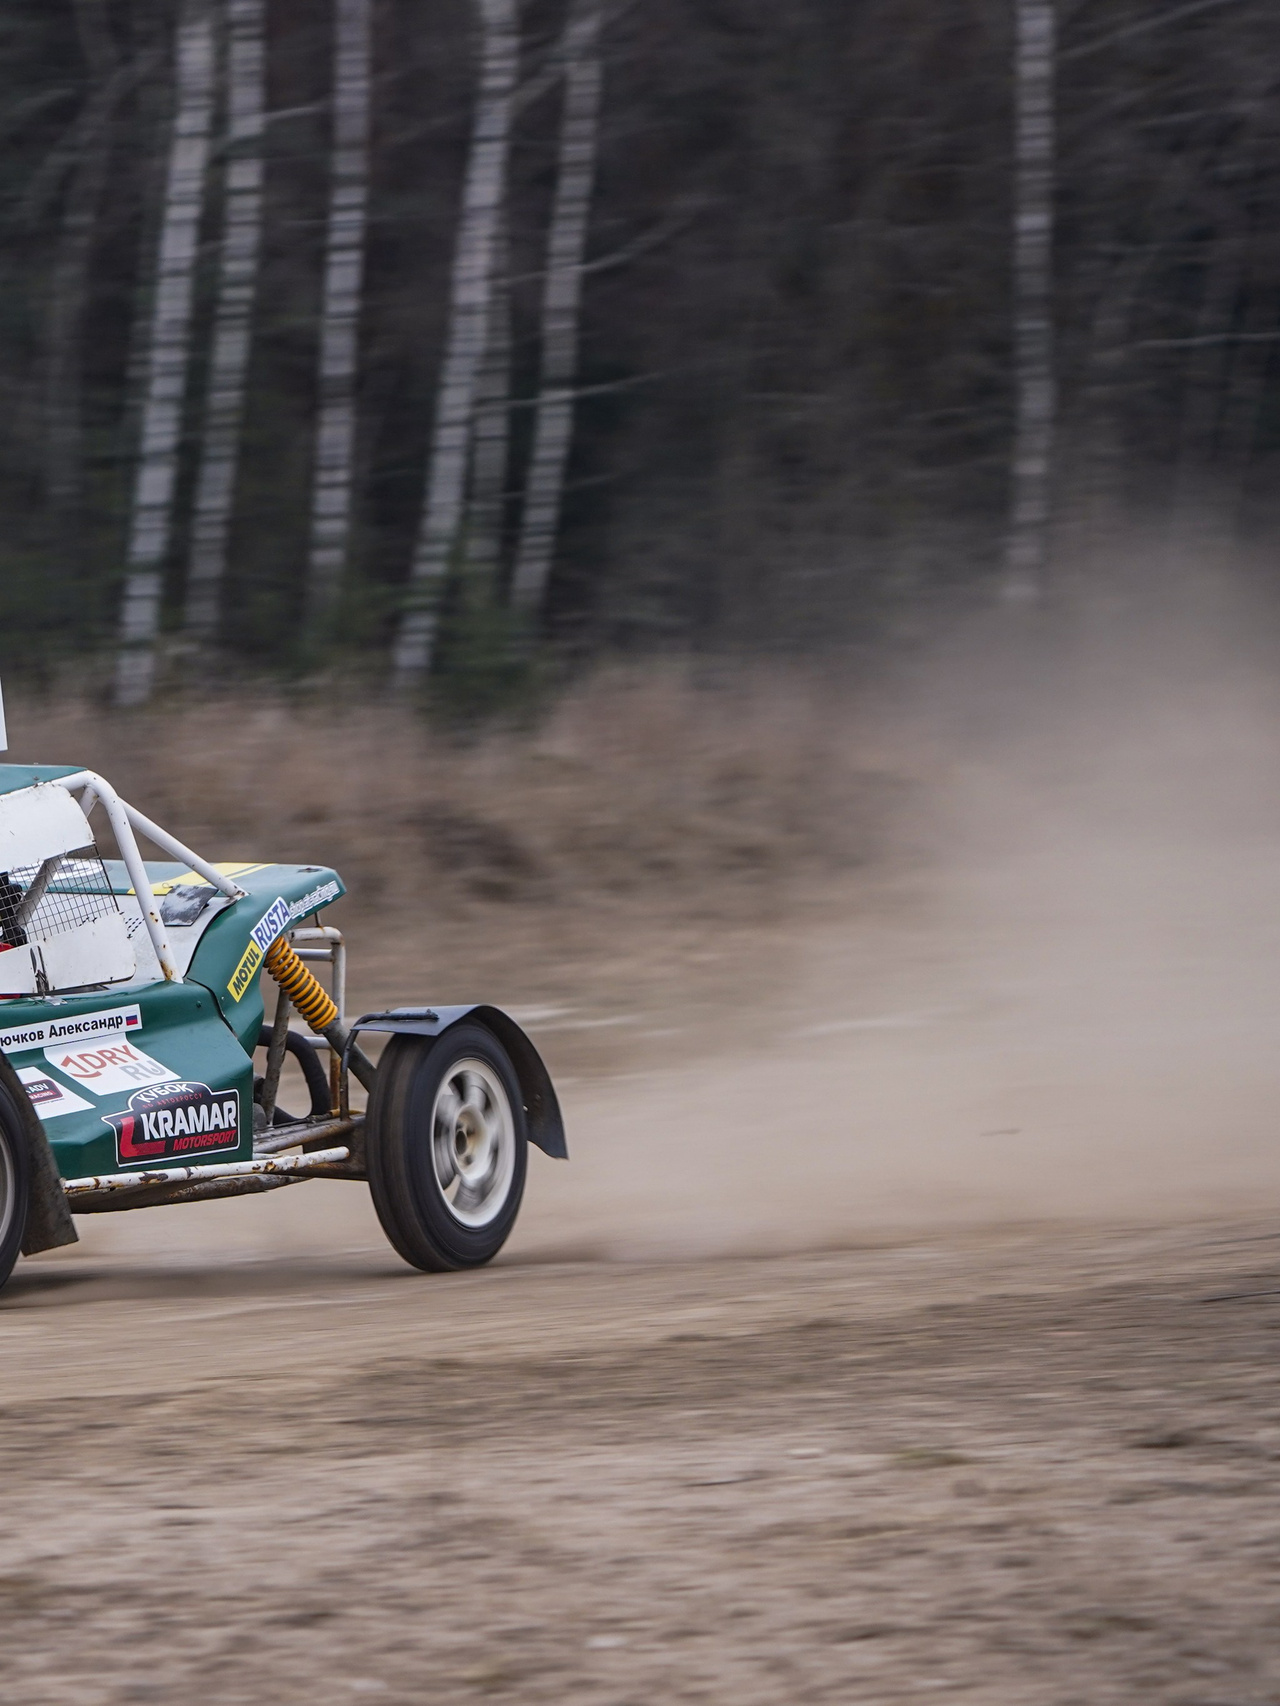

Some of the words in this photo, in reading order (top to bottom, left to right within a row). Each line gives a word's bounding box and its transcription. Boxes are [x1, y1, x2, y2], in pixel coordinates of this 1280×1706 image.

[254, 898, 291, 950] RUSTA
[232, 948, 260, 995] MOTUL
[48, 1014, 124, 1039] Александр
[60, 1044, 139, 1079] 1DRY
[119, 1060, 167, 1081] RU
[136, 1083, 194, 1103] КУБОК
[140, 1100, 237, 1140] KRAMAR
[173, 1129, 237, 1152] MOTORSPORT
